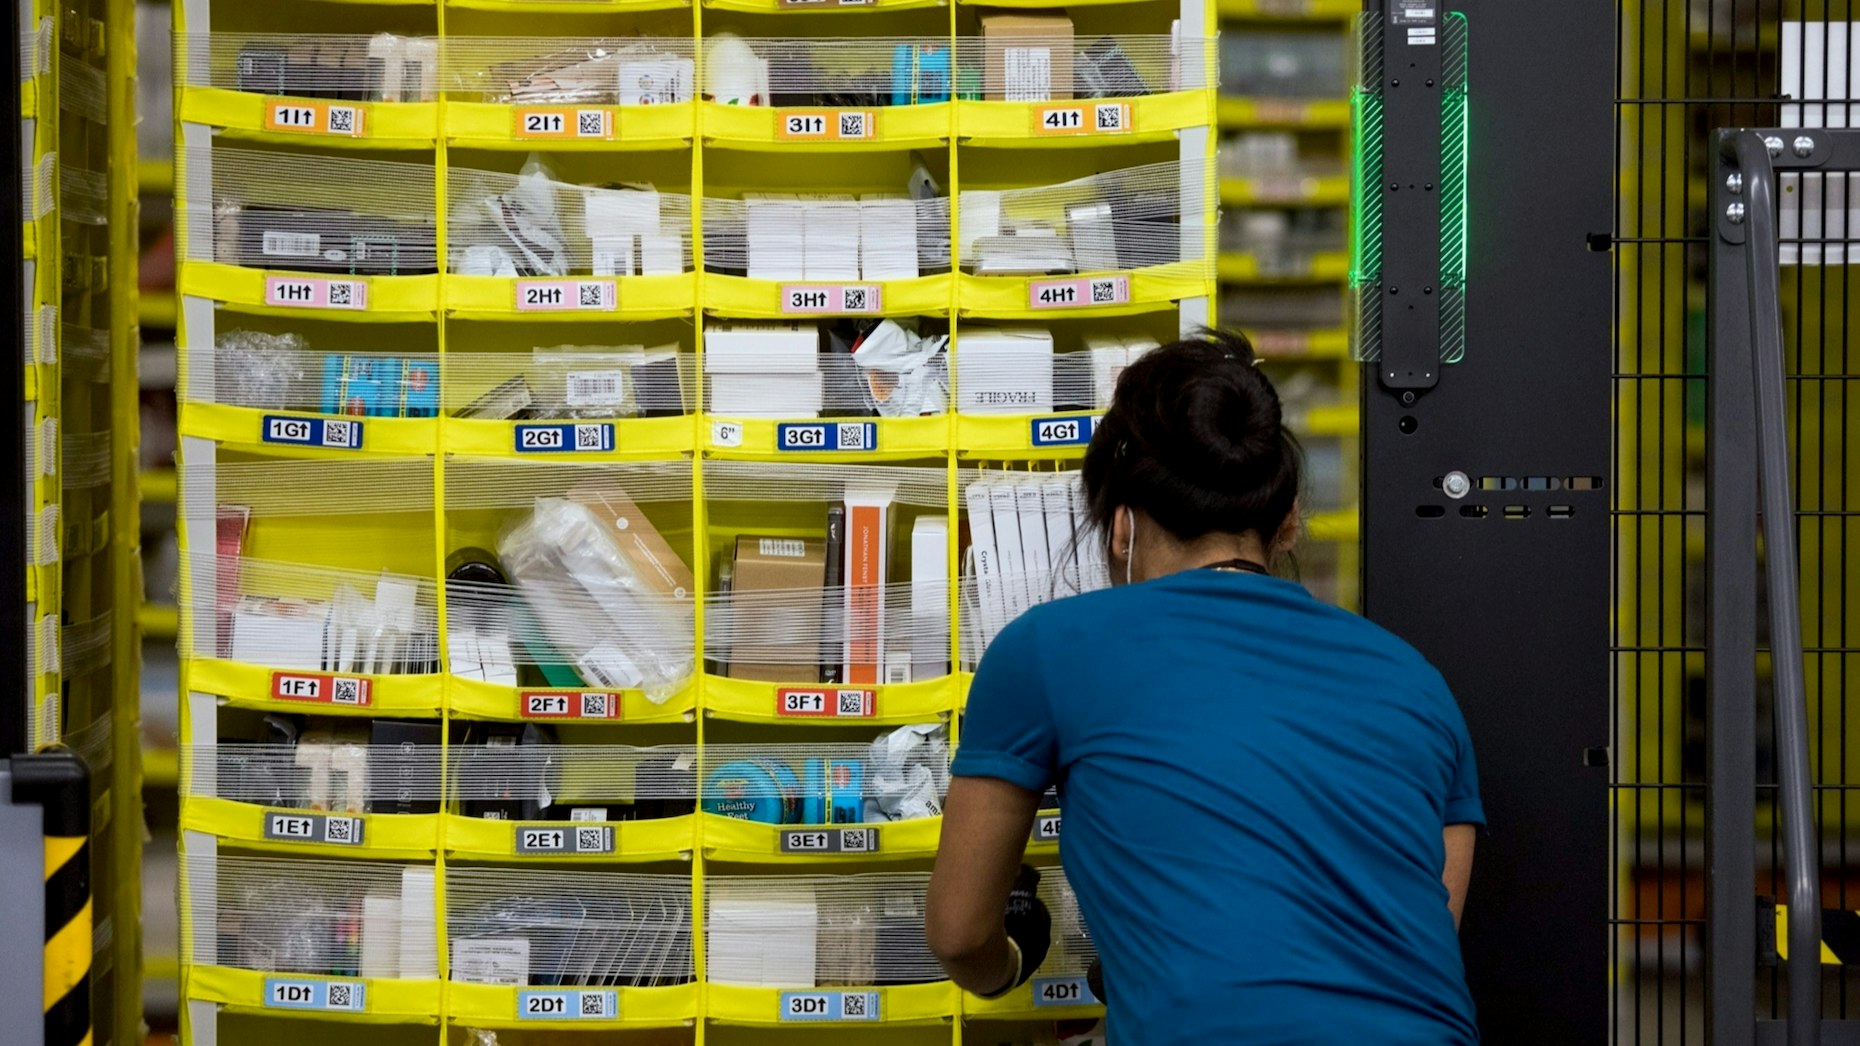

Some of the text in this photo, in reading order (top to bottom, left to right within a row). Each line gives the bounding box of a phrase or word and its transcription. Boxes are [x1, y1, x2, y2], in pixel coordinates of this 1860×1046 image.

[276, 284, 302, 300] 1H
[527, 289, 552, 304] 2H
[791, 292, 817, 307] 3H
[1039, 288, 1066, 303] 4H
[975, 391, 1037, 403] FRAGILE
[272, 422, 299, 437] 1G
[787, 429, 814, 445] 3G
[1040, 424, 1068, 440] 4G
[526, 431, 552, 446] 2G
[980, 550, 989, 576] Crysta
[281, 680, 305, 695] 1F
[530, 698, 554, 712] 2F
[786, 695, 810, 710] 3F
[717, 801, 756, 812] Healthy
[274, 819, 300, 834] 1E
[525, 833, 551, 848] 2E
[789, 833, 815, 848] 3E
[275, 986, 302, 1001] 1D
[1042, 983, 1070, 1000] 4D
[528, 998, 555, 1013] 2D
[790, 998, 817, 1013] 3D
